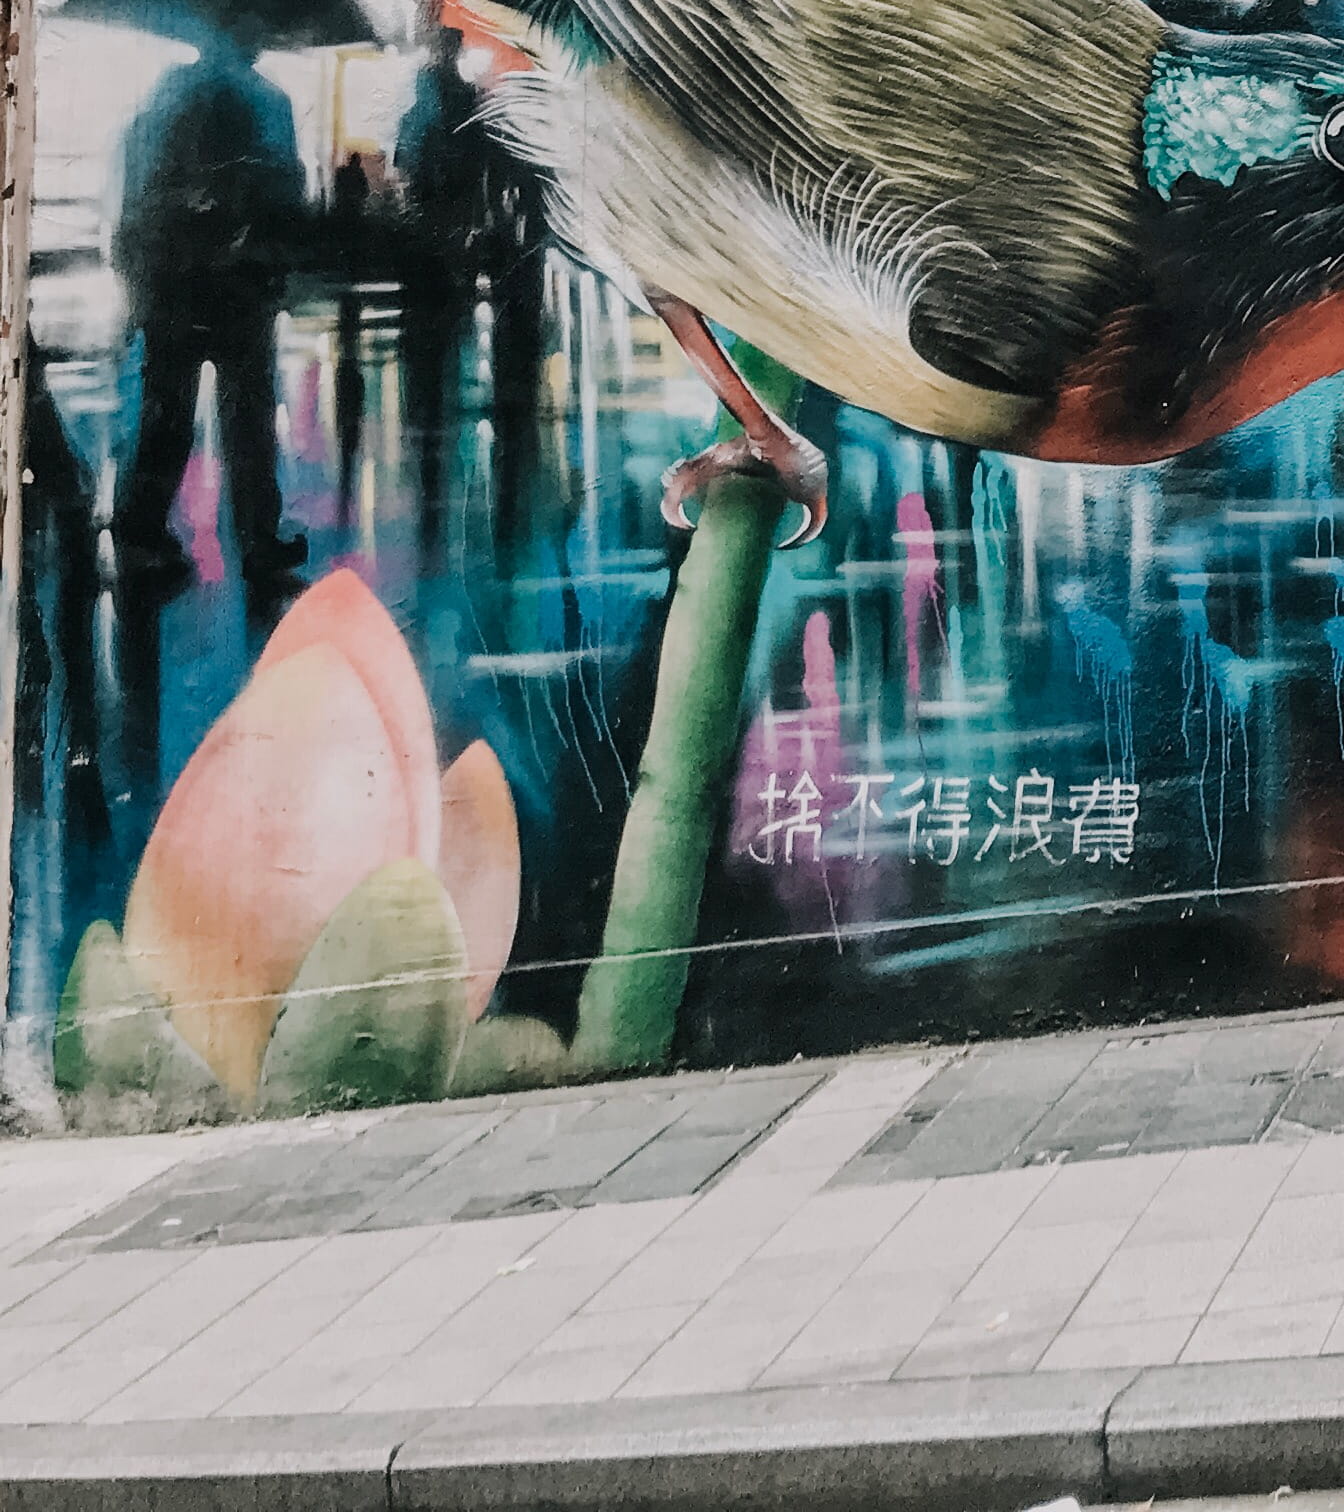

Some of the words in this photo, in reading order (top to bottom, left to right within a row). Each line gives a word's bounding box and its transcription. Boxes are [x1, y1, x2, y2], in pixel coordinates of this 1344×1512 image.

[748, 768, 1140, 867] 捨不得浪費
